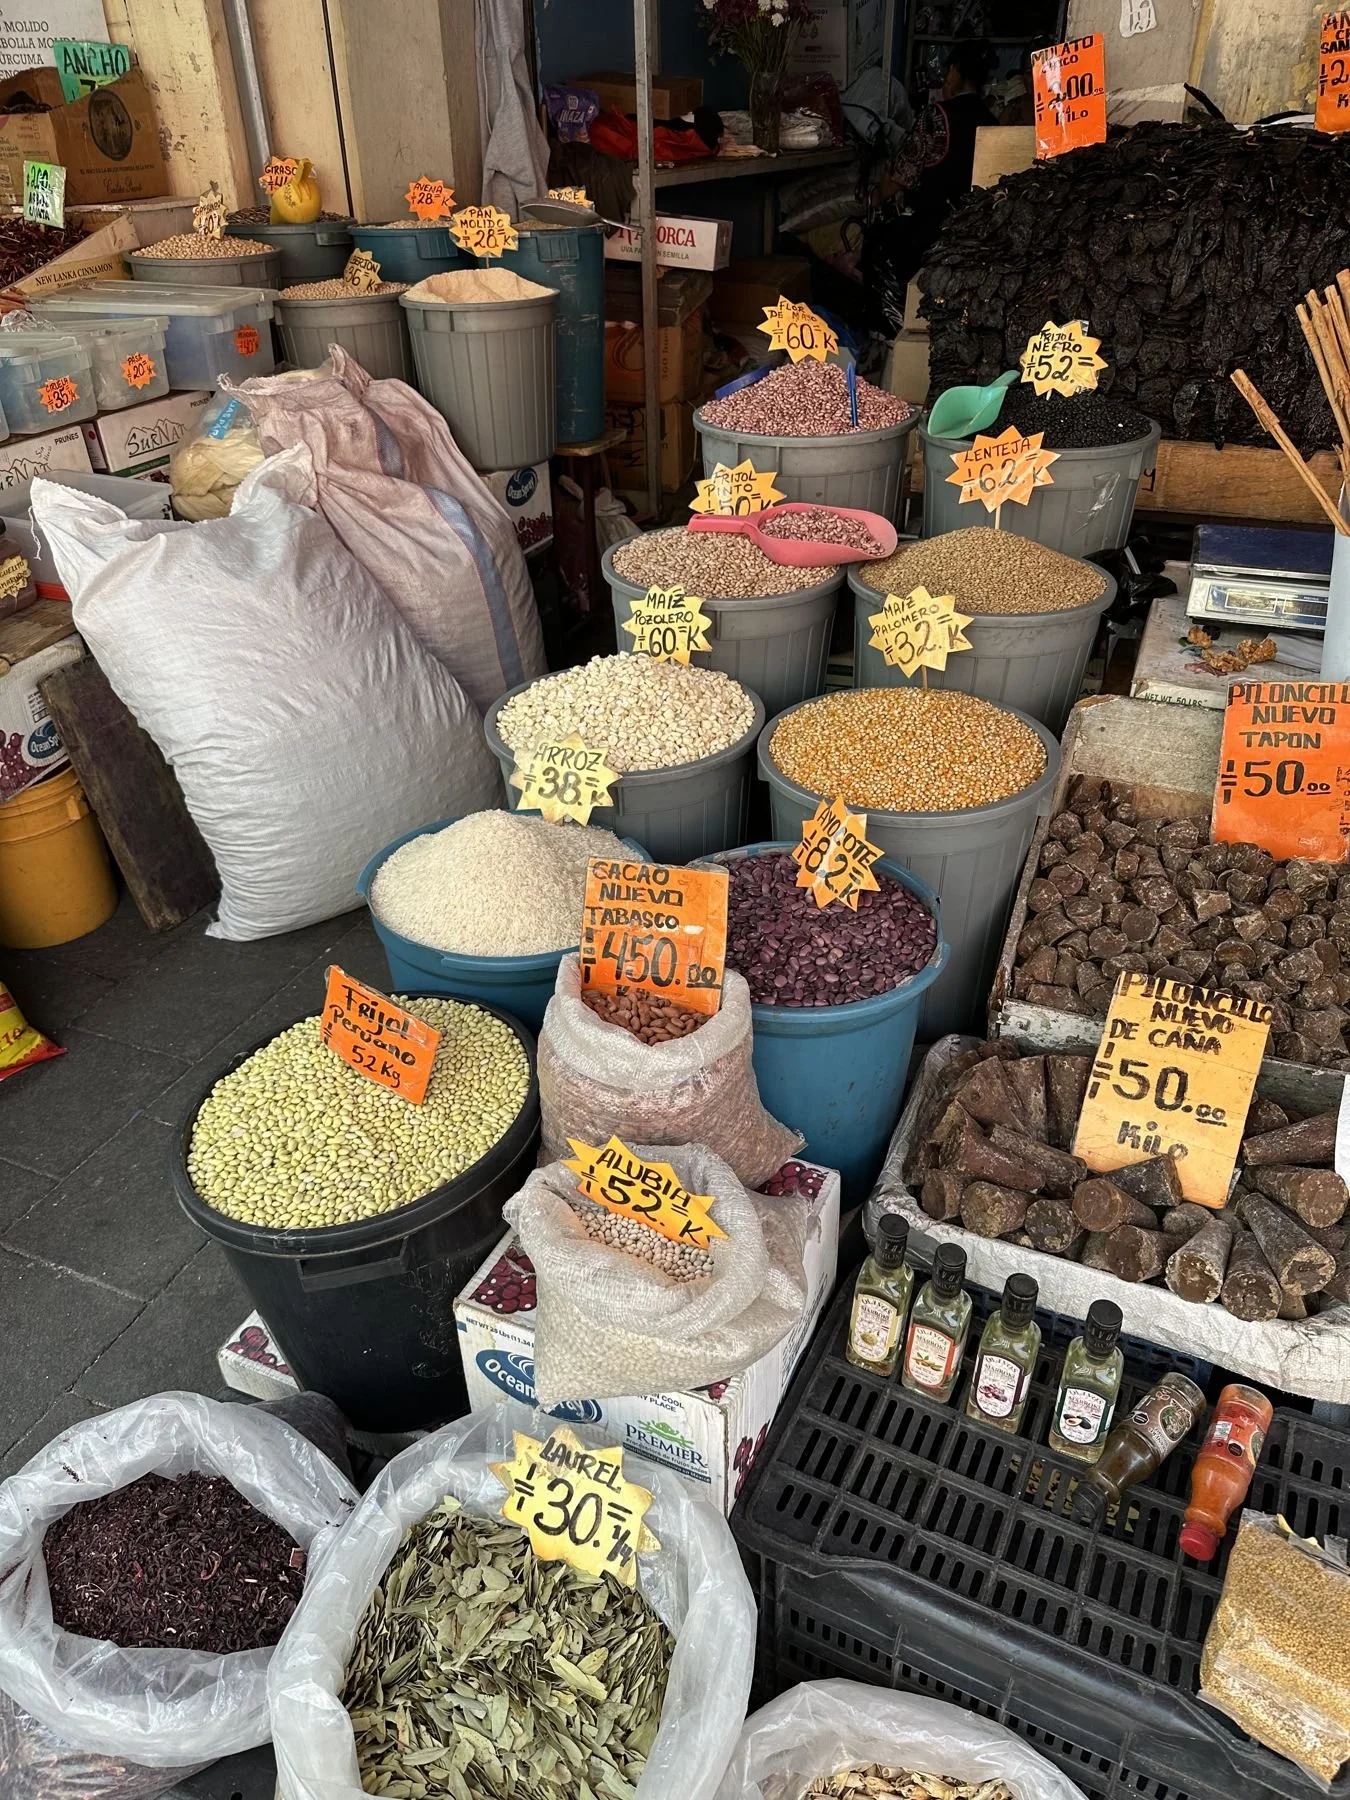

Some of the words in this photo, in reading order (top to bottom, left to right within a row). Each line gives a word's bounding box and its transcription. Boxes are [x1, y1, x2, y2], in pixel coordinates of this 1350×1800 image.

[5, 21, 49, 32] MOLIDO
[63, 47, 127, 77] ANCHO
[413, 183, 443, 194] AVENA
[468, 208, 492, 220] PAN
[662, 250, 690, 261] SEMILLA
[35, 274, 52, 286] NEW
[53, 268, 78, 282] LANKA
[77, 262, 114, 277] CINNAMON
[768, 309, 784, 319] DE
[791, 311, 819, 323] MAYO
[779, 300, 805, 313] FLOR
[823, 331, 836, 351] K
[1031, 341, 1083, 354] NEGRO
[127, 353, 144, 366] PASA
[46, 377, 69, 393] CIRUELA
[54, 432, 80, 446] PRUNES
[964, 437, 1031, 463] LENTEJA
[714, 469, 757, 484] FRIJOL
[1033, 466, 1045, 483] K
[703, 483, 753, 497] PINTO
[647, 591, 686, 610] MAIZ
[883, 596, 916, 619] MAIZ
[634, 609, 694, 625] POZOLERO
[873, 604, 940, 638] PALOMERO
[687, 625, 701, 651] K
[948, 624, 967, 649] K
[1144, 692, 1159, 703] NET
[1176, 696, 1187, 706] 50
[1251, 705, 1336, 725] NUEVO
[1239, 731, 1321, 749] TAPON
[533, 742, 602, 772] ARROZ
[590, 790, 606, 806] K
[592, 861, 670, 886] CACAO
[599, 883, 684, 907] NUEVO
[839, 882, 859, 907] K
[585, 906, 680, 929] TABASCO
[1121, 971, 1274, 1024] PILONCILLO
[1150, 1001, 1236, 1034] NUEVO
[329, 1004, 417, 1067] Peruano
[1109, 1018, 1140, 1041] DE
[596, 1149, 692, 1208] ALUBIA
[679, 1220, 703, 1245] K
[465, 1316, 478, 1326] NET
[478, 1321, 489, 1331] WT
[484, 1358, 537, 1399] Ocean
[650, 1397, 677, 1413] PLACE
[661, 1395, 685, 1409] COOL
[625, 1422, 709, 1468] PREMIER
[539, 1437, 622, 1494] LAUREL
